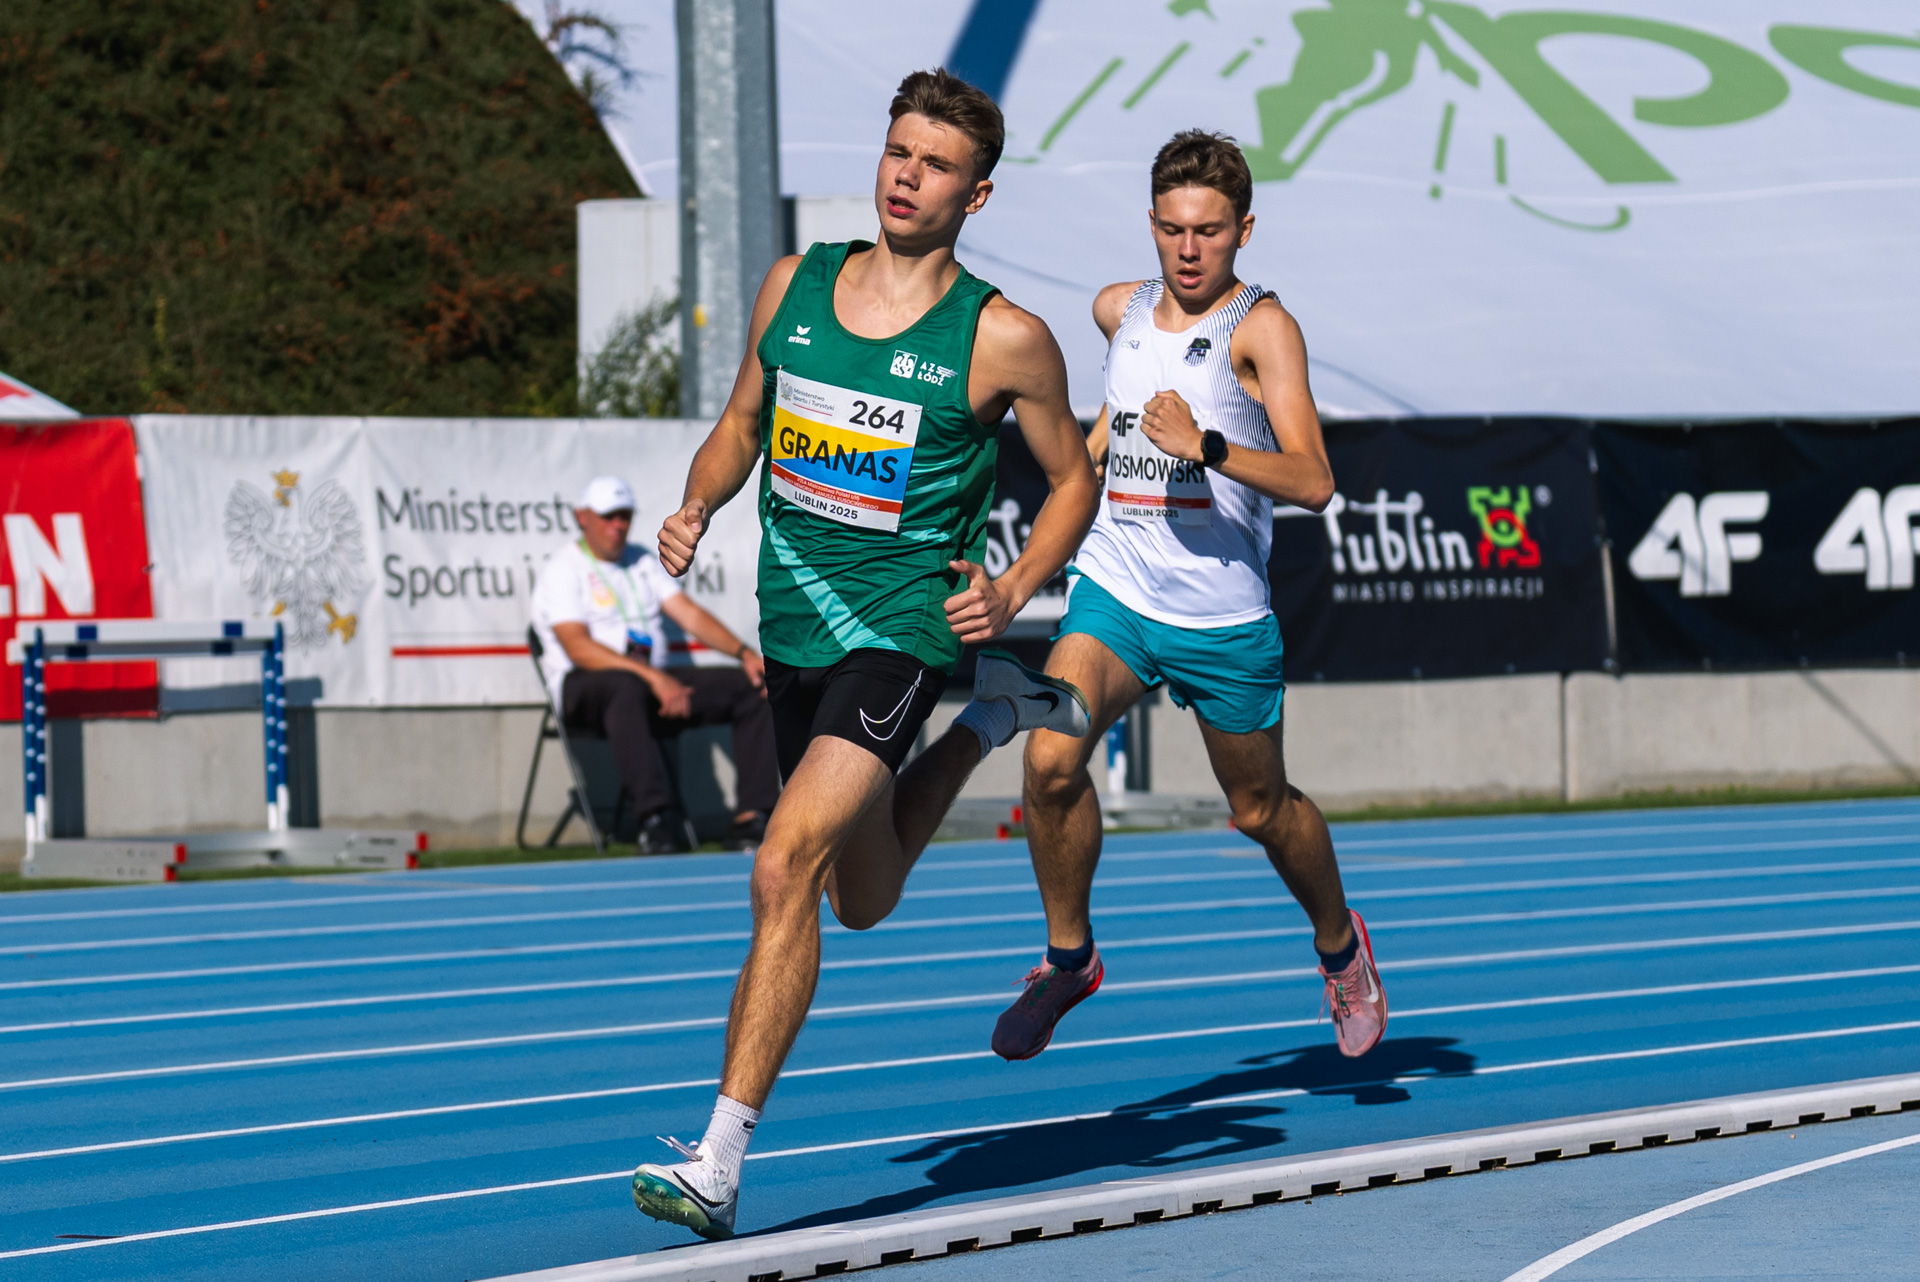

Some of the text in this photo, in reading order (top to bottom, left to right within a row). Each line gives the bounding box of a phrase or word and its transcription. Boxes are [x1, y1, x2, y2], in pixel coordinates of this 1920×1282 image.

[788, 335, 811, 346] erima
[849, 400, 905, 434] 264
[1111, 410, 1139, 437] 4F
[780, 427, 898, 484] GRANAS
[376, 487, 578, 534] Ministerst
[794, 490, 858, 520] LUBLIN 2025
[1122, 507, 1180, 518] LUBLIN 2025
[1628, 491, 1770, 597] 4F
[384, 554, 515, 607] Sportu
[1332, 576, 1545, 602] MIASTO INSPIRACJI
